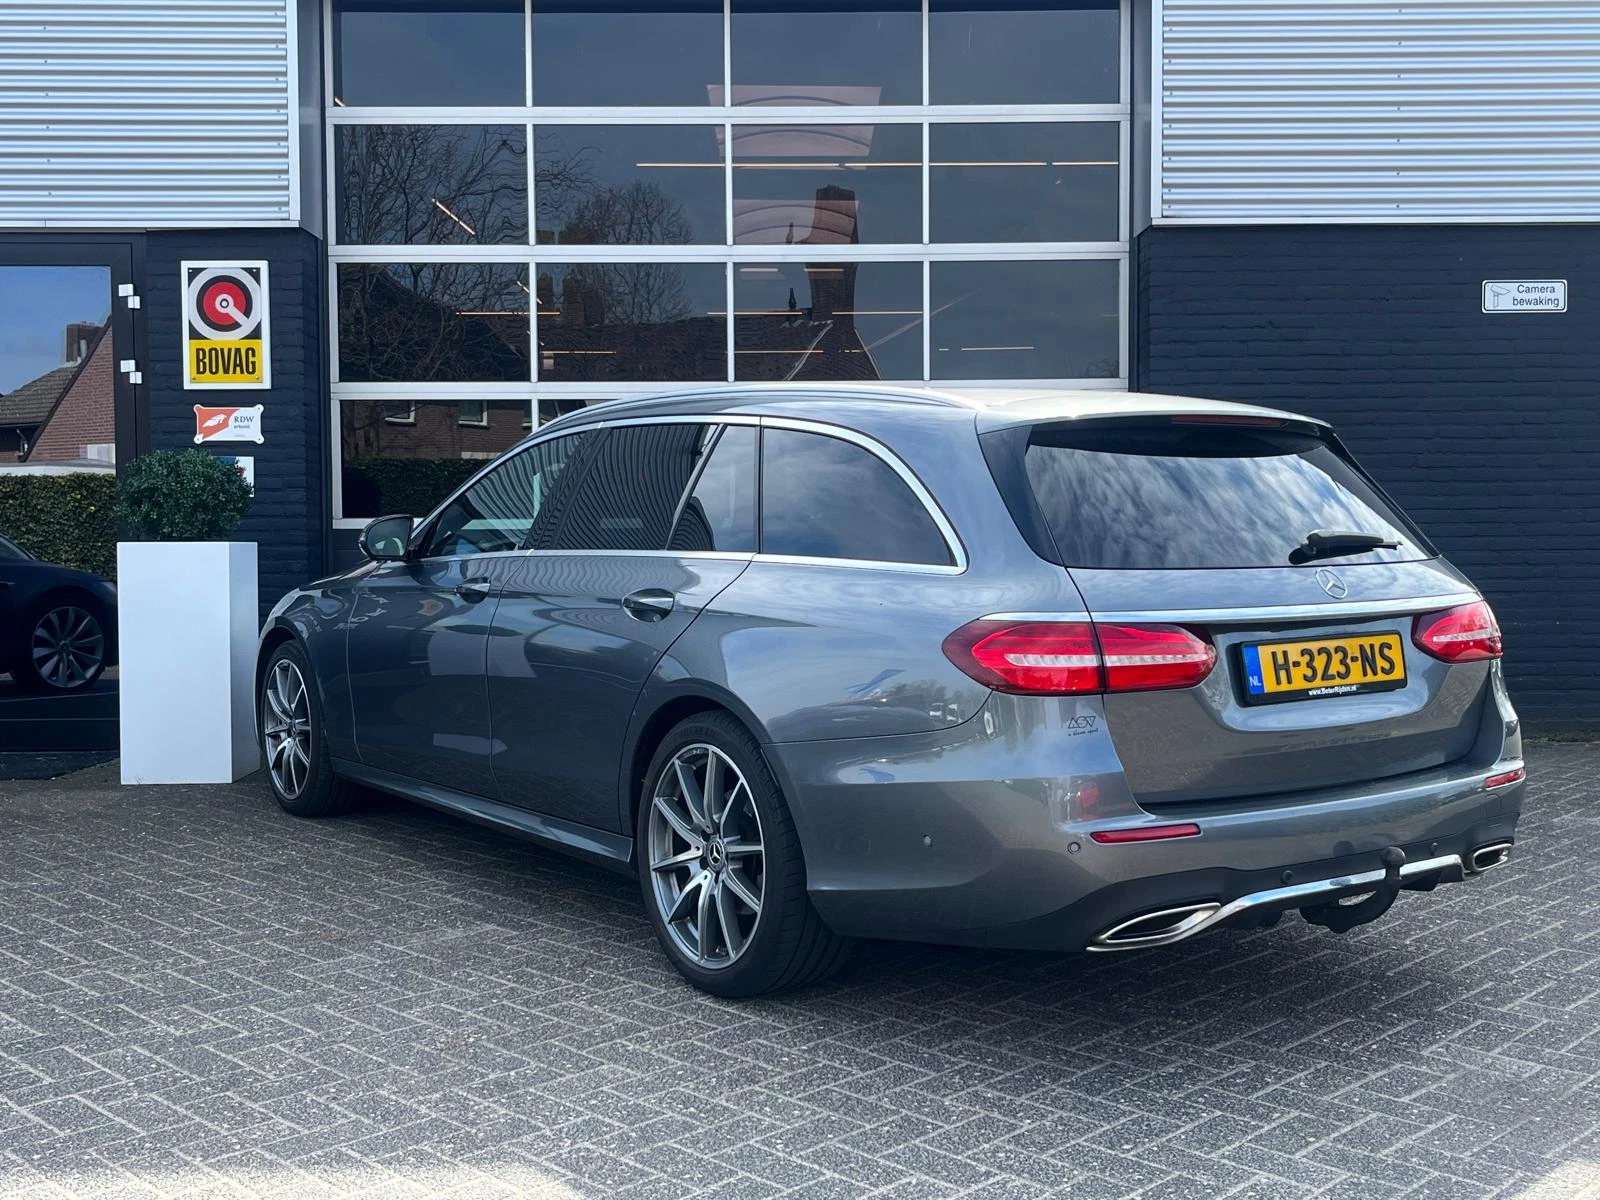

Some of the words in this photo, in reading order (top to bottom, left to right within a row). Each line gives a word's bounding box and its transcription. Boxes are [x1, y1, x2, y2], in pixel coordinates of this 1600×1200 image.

[1517, 284, 1556, 294] Camera
[1512, 296, 1560, 308] bewaking
[195, 347, 257, 375] BOVAG
[233, 415, 255, 423] RDW
[1271, 642, 1396, 686] H-323-NS
[1249, 675, 1262, 686] NL
